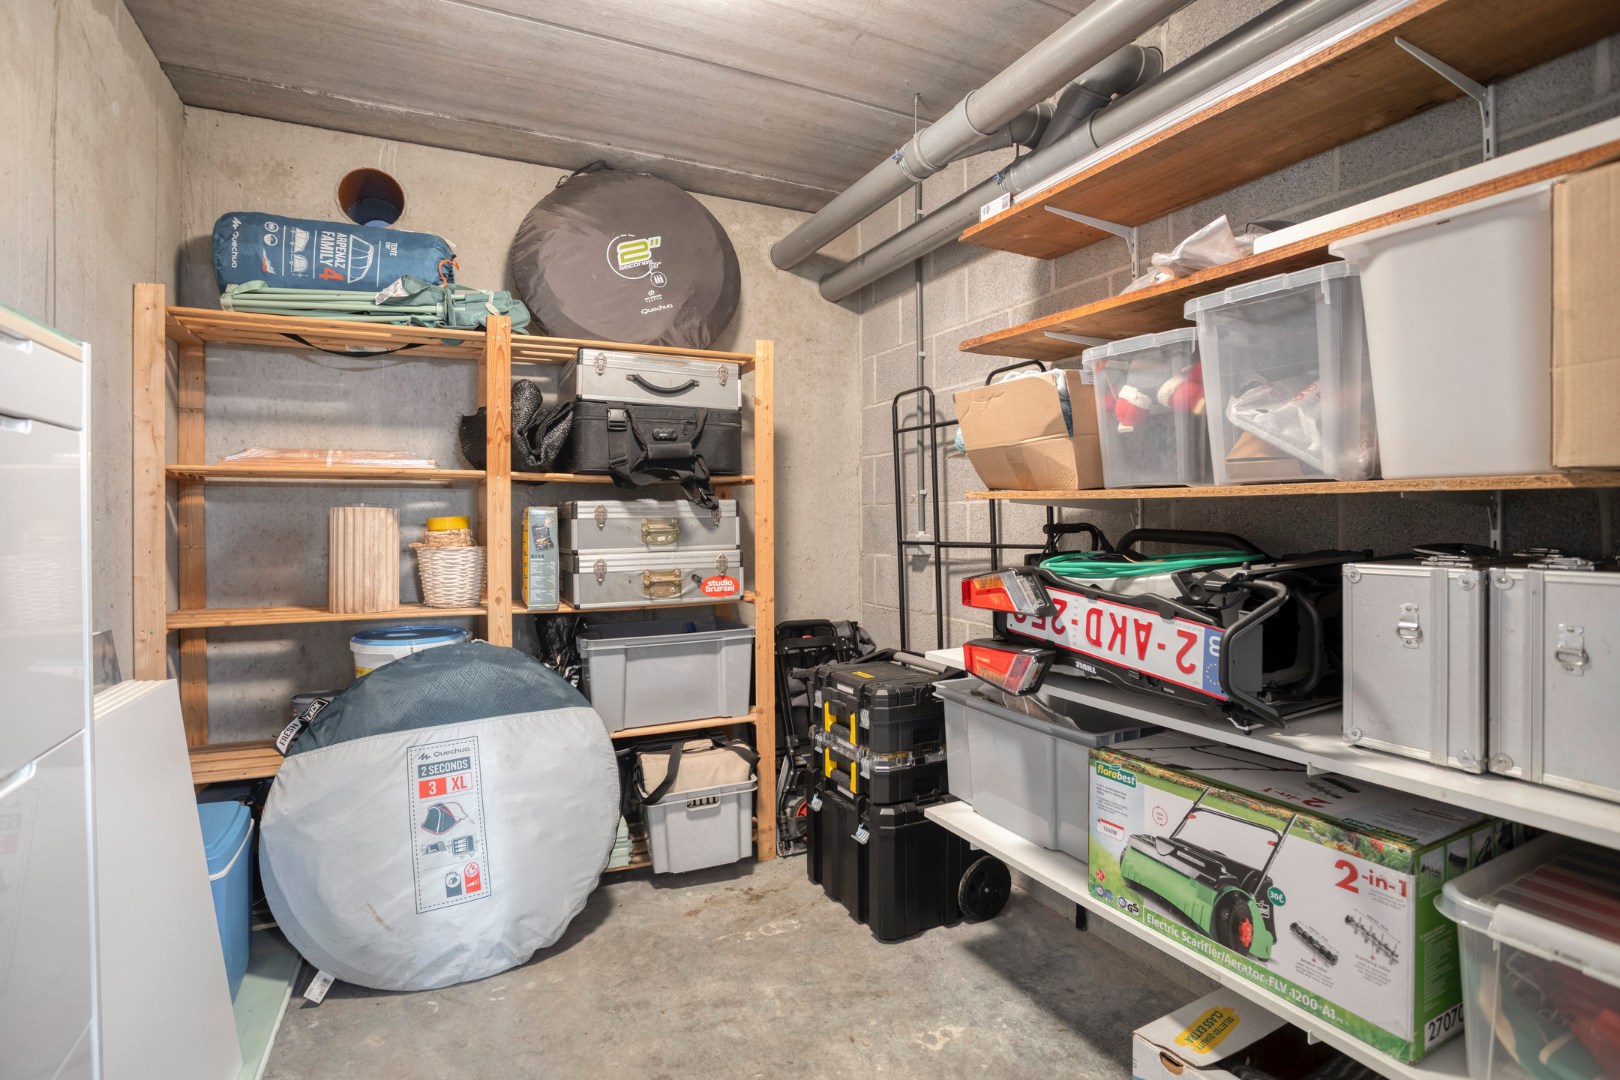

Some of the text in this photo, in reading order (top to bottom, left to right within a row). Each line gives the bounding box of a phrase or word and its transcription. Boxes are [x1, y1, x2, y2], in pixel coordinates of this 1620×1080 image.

[230, 231, 239, 269] Quechua
[319, 230, 335, 267] FAMILY
[334, 232, 347, 269] ARPENAZ
[319, 267, 345, 281] 4
[640, 303, 674, 315] Quechua
[705, 585, 736, 594] brussel
[707, 579, 733, 588] studio
[1013, 597, 1198, 675] 2-AKD-2
[1075, 660, 1097, 675] THULE
[304, 701, 322, 722] LACK
[279, 722, 299, 746] FRESH
[433, 746, 471, 758] Quechua
[420, 759, 469, 776] 2 SECONDS
[1097, 764, 1136, 786] florabest
[428, 775, 468, 795] 3 XL
[1334, 859, 1408, 898] 2-in-1
[1127, 903, 1139, 913] GS
[1146, 913, 1336, 1020] Electric Scarifier/Aerator FLV 1200 A1
[1184, 1010, 1223, 1044] CLASS EXTRA
[1212, 1016, 1235, 1036] SELECTED
